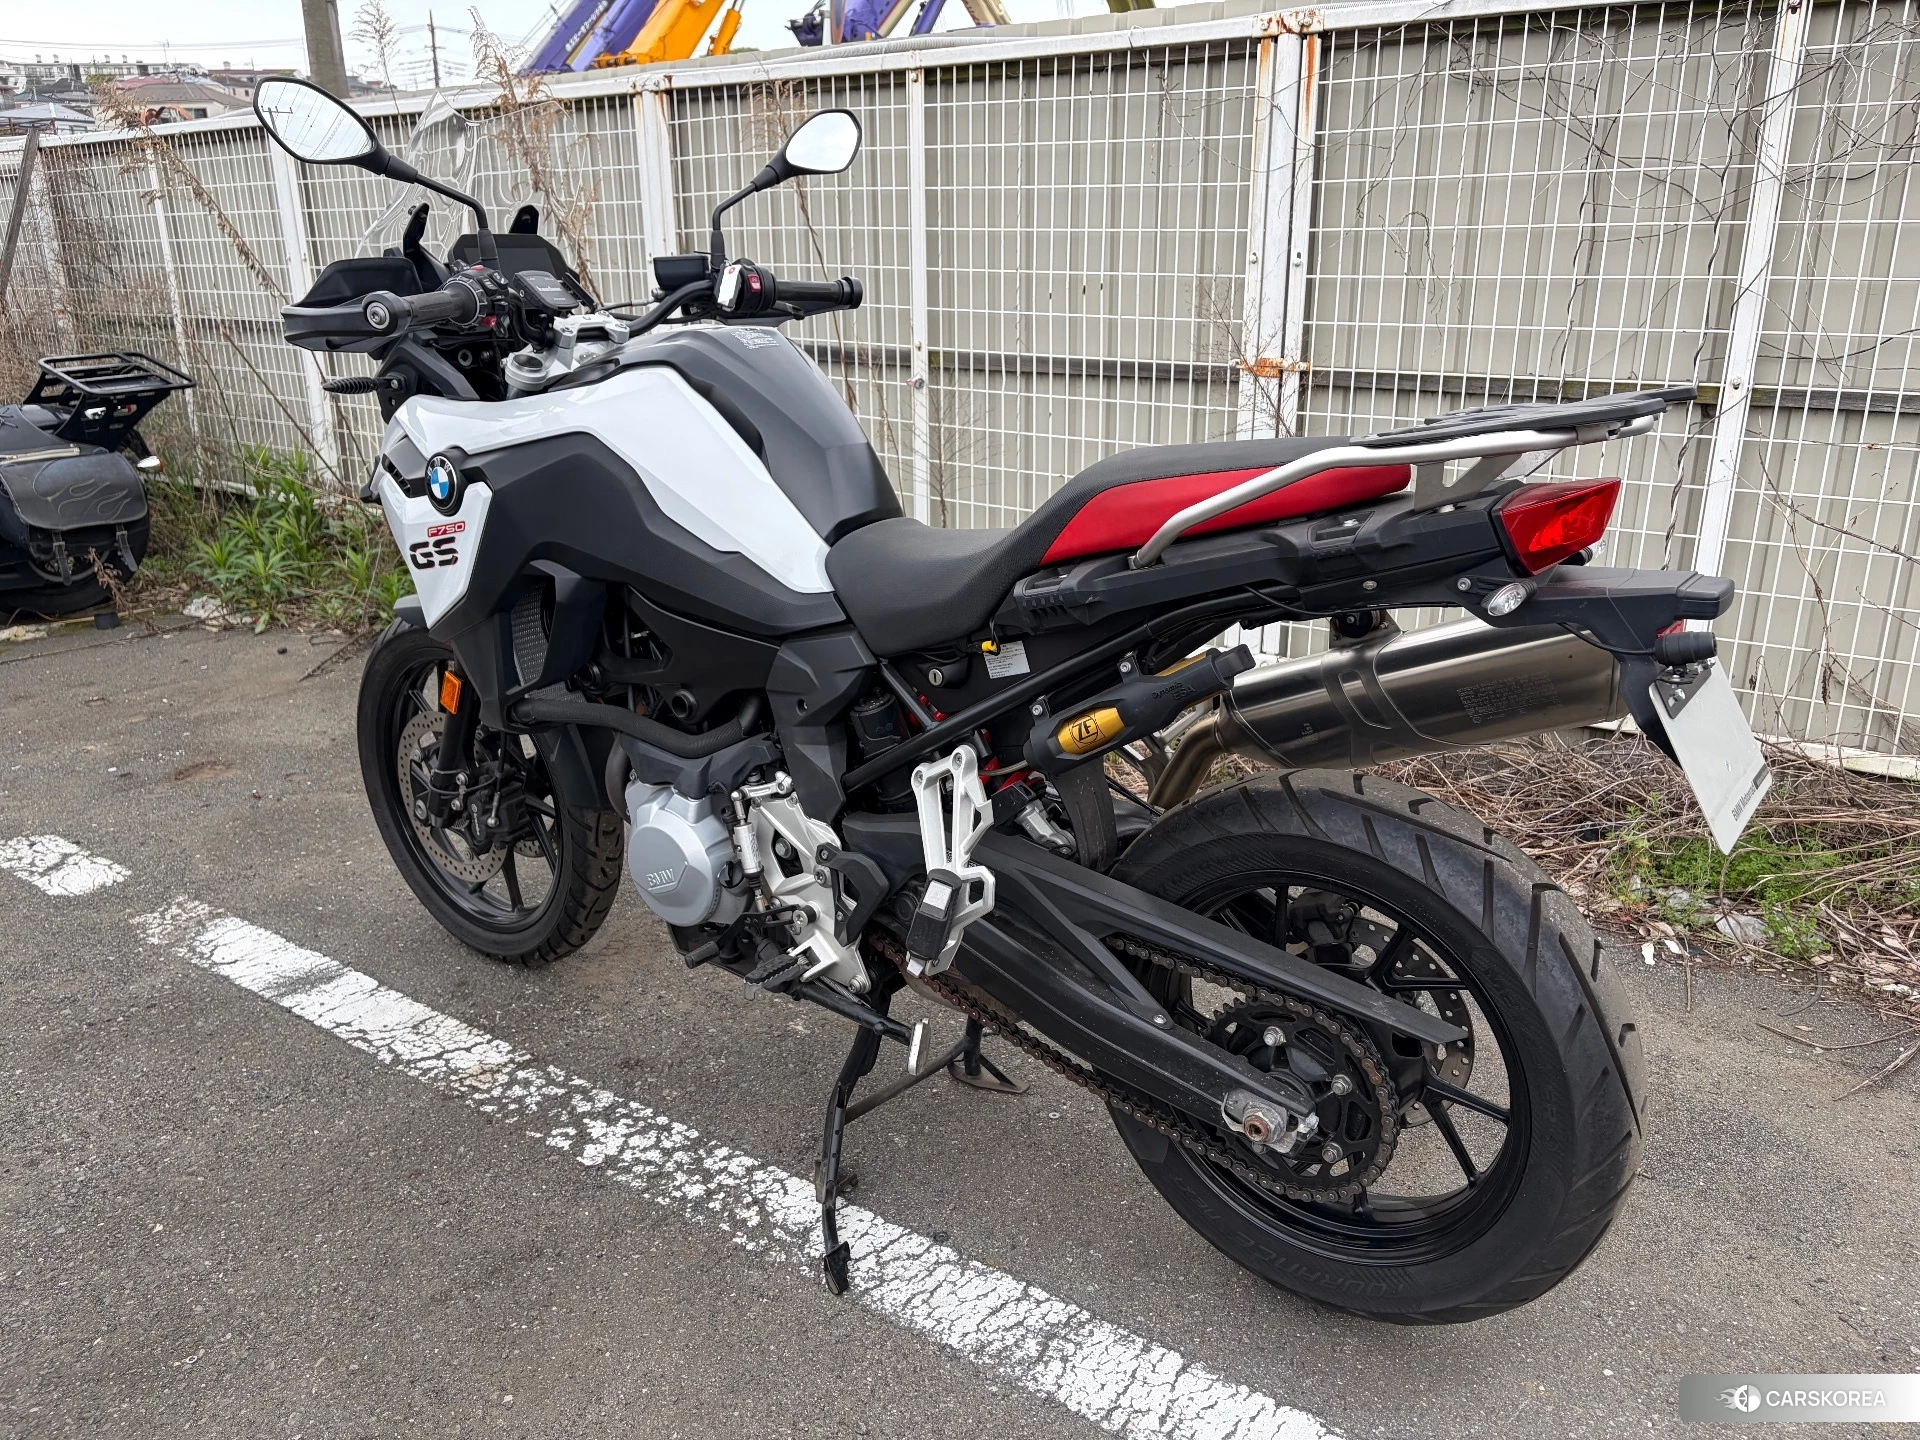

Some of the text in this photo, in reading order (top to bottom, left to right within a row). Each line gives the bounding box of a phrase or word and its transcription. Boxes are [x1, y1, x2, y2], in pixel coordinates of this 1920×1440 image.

[428, 523, 465, 537] F750
[409, 536, 459, 570] GS
[1151, 682, 1183, 699] Dynamic
[1172, 684, 1196, 701] ESA
[1071, 720, 1098, 742] ZF
[646, 868, 675, 887] BMW
